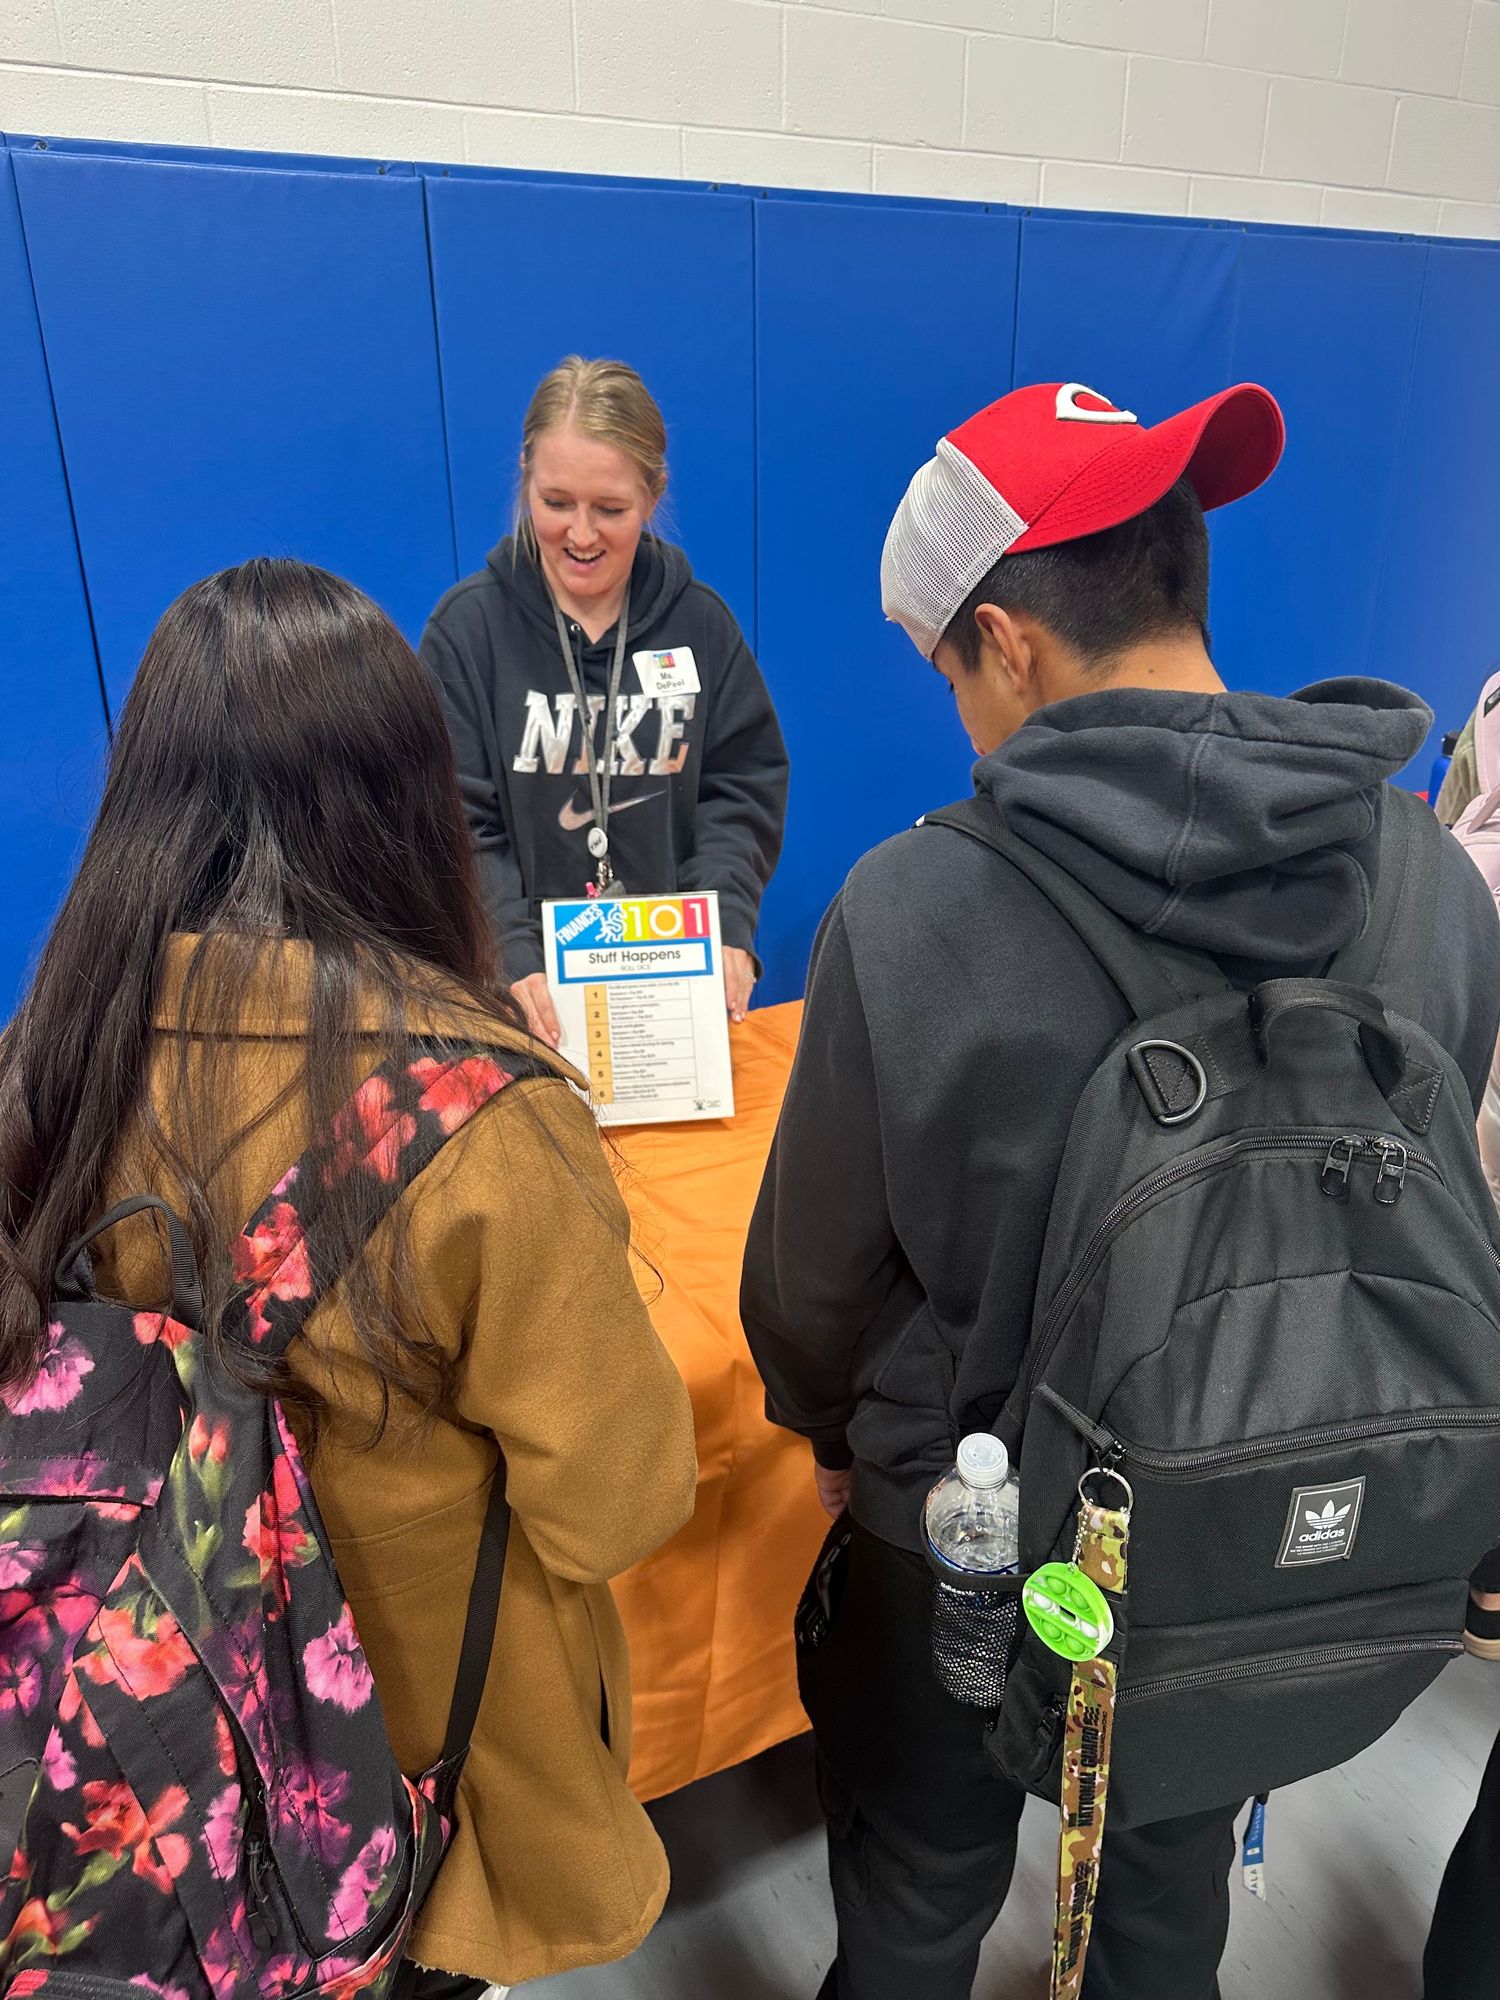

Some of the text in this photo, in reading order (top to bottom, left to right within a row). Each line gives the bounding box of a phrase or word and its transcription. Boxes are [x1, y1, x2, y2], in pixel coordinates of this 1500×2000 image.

[512, 689, 696, 776] NIKE
[555, 903, 704, 946] FINANCES 101
[588, 948, 681, 965] Stuff Happens
[1299, 1528, 1346, 1542] adidas
